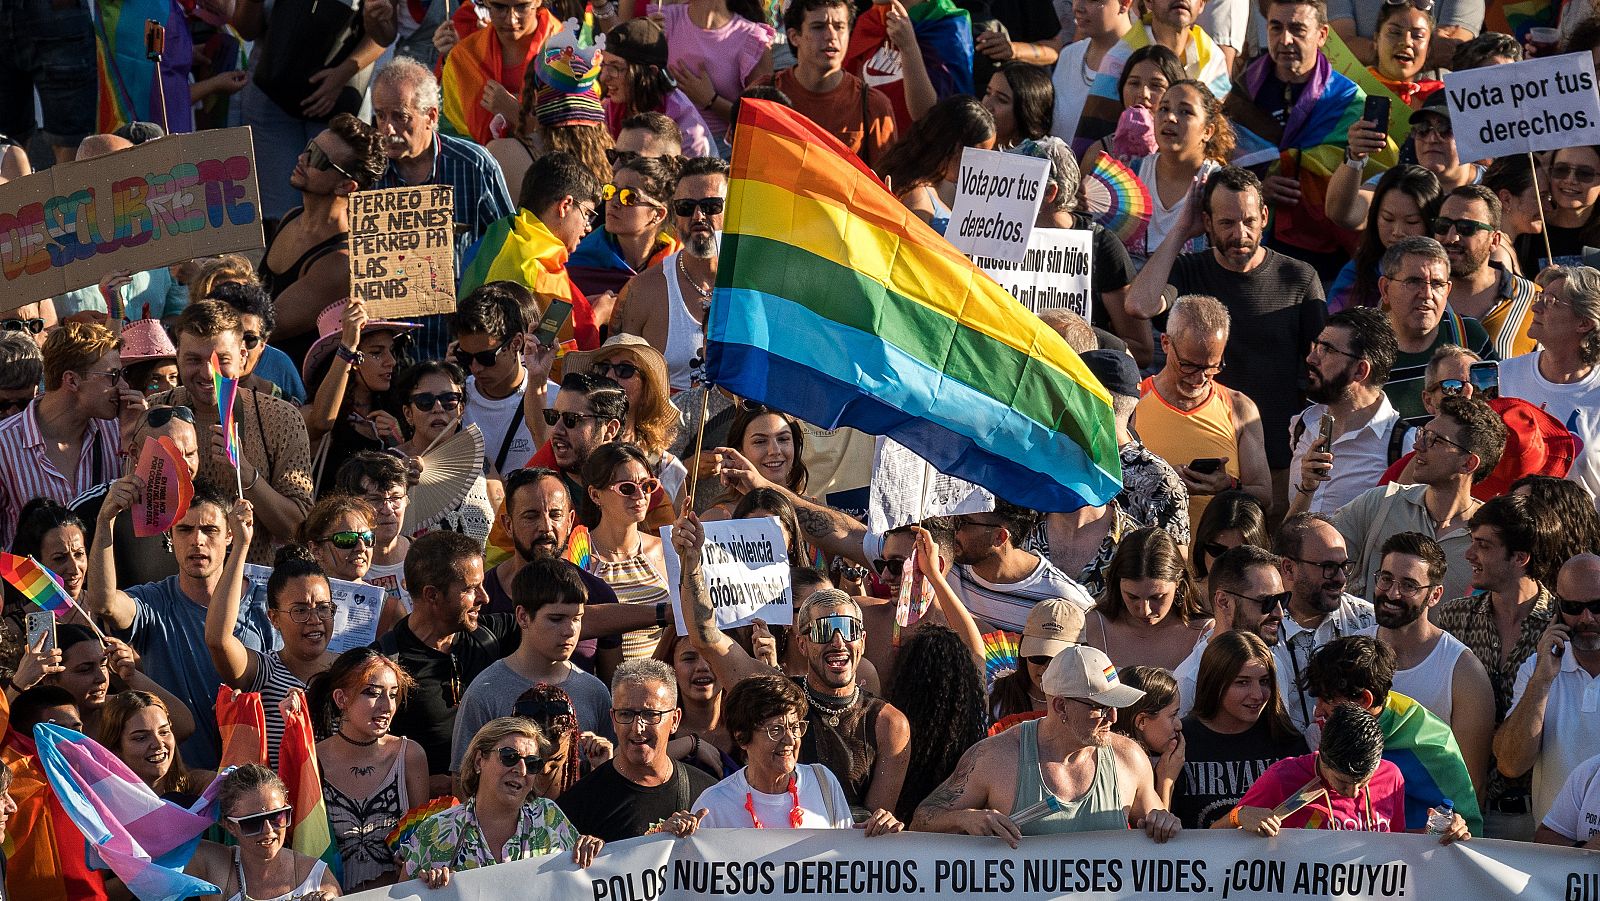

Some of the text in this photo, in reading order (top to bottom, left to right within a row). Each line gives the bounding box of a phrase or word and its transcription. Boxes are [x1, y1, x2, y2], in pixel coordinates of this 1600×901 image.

[1450, 71, 1593, 112] Vota por tus
[1480, 109, 1595, 144] derechos.
[961, 165, 1039, 202] Vota por tus
[353, 187, 450, 215] PERREO PA
[0, 155, 255, 280] DESCUBRETE
[352, 207, 452, 236] LOS NENES
[959, 209, 1024, 243] derechos.
[353, 228, 448, 256] PERREO PA
[353, 256, 388, 280] LAS
[1047, 246, 1062, 273] sin
[1062, 246, 1089, 277] hijos
[354, 278, 409, 301] NENAS
[1019, 285, 1037, 313] mil
[1037, 286, 1088, 317] millones!
[704, 535, 729, 565] más
[728, 533, 774, 563] violencia
[1184, 758, 1279, 795] NIRVA
[591, 858, 1407, 901] POLOS NUESOS DERECHOS. POLES NUESES VIDES. ¡CON ARGUYU!
